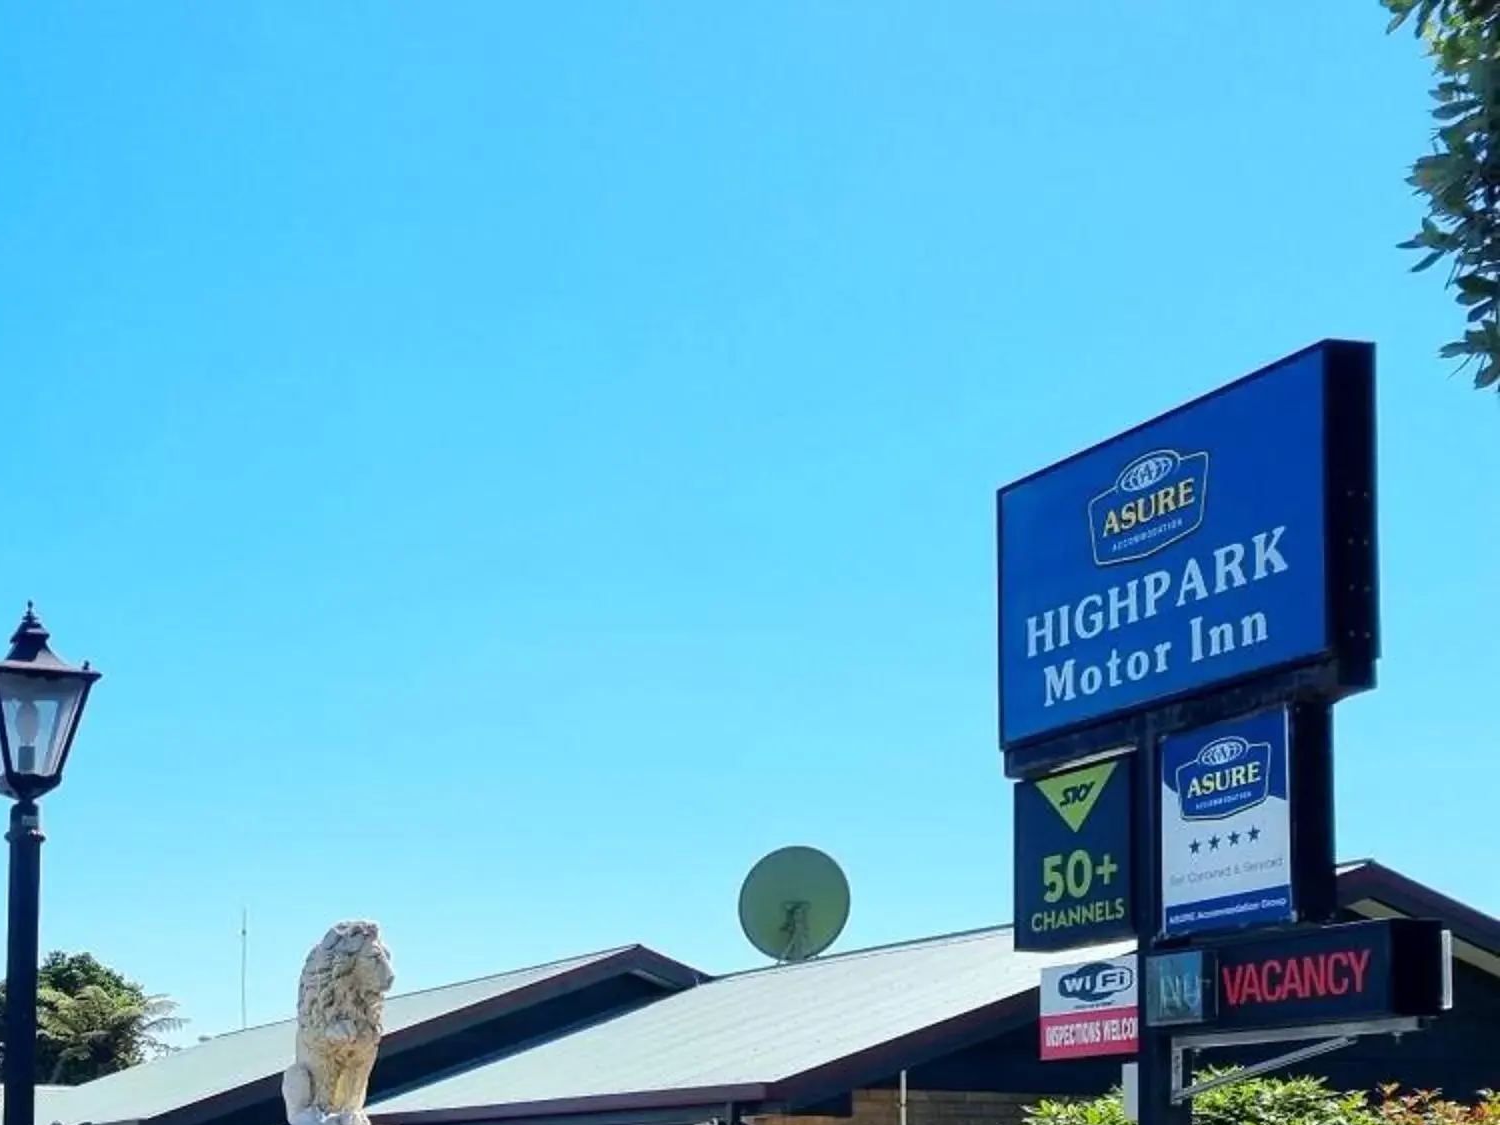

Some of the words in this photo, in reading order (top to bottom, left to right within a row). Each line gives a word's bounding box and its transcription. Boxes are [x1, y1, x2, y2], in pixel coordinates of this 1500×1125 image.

[1102, 477, 1196, 538] ASURE
[1026, 525, 1289, 658] HIGHPARK
[1043, 640, 1172, 708] Motor
[1189, 609, 1269, 663] Inn
[1187, 760, 1261, 799] ASURE
[1043, 849, 1118, 903] 50+
[1031, 898, 1125, 932] CHANNELS
[1222, 949, 1371, 1006] VACANCY
